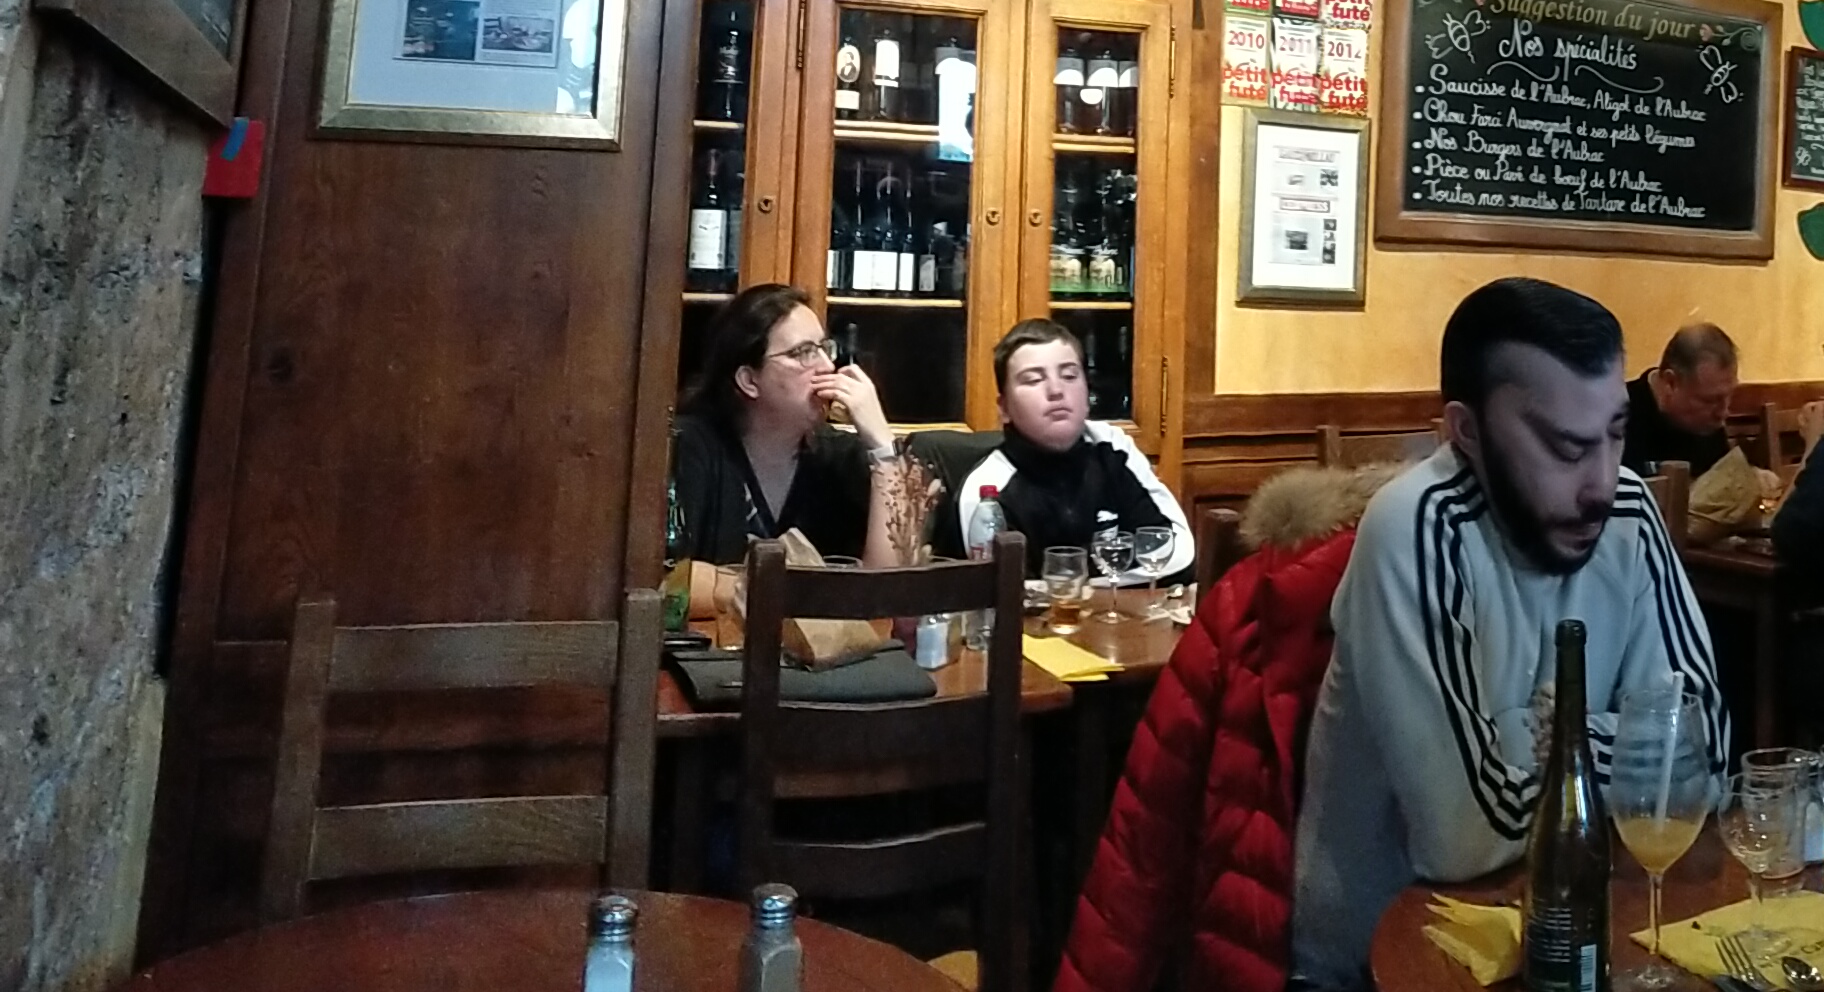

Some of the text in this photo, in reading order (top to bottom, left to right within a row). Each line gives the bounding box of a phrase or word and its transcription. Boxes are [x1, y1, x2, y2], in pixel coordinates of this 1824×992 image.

[1333, 3, 1371, 21] futé
[1614, 3, 1643, 31] du
[1643, 13, 1696, 41] jour
[1228, 30, 1265, 49] 2010
[1327, 41, 1363, 59] 2012
[1499, 18, 1637, 82] Nos spécialités
[1222, 66, 1268, 84] petit
[1321, 74, 1367, 93] petit
[1428, 63, 1507, 96] Saucisse
[1510, 78, 1527, 100] de
[1593, 89, 1631, 121] Aligot
[1634, 97, 1651, 115] de
[1655, 96, 1707, 121] l'Aubrac
[1423, 97, 1467, 124] Chou
[1506, 107, 1573, 145] Auvergnat
[1576, 121, 1588, 136] et
[1590, 126, 1608, 139] ses
[1610, 123, 1641, 148] petits
[1645, 124, 1696, 154] légumes
[1423, 127, 1605, 162] Nos Burgers de l'Aubrac
[1423, 153, 1470, 179] Pièce
[1474, 168, 1491, 181] ou
[1529, 165, 1547, 185] de
[1590, 171, 1605, 189] de
[1609, 168, 1663, 192] l'Aubrac
[1422, 178, 1476, 205] Toutes
[1477, 193, 1505, 207] nos
[1507, 191, 1559, 210] recettes
[1561, 194, 1576, 211] de
[1573, 190, 1626, 212] Tartare
[1630, 193, 1647, 213] de
